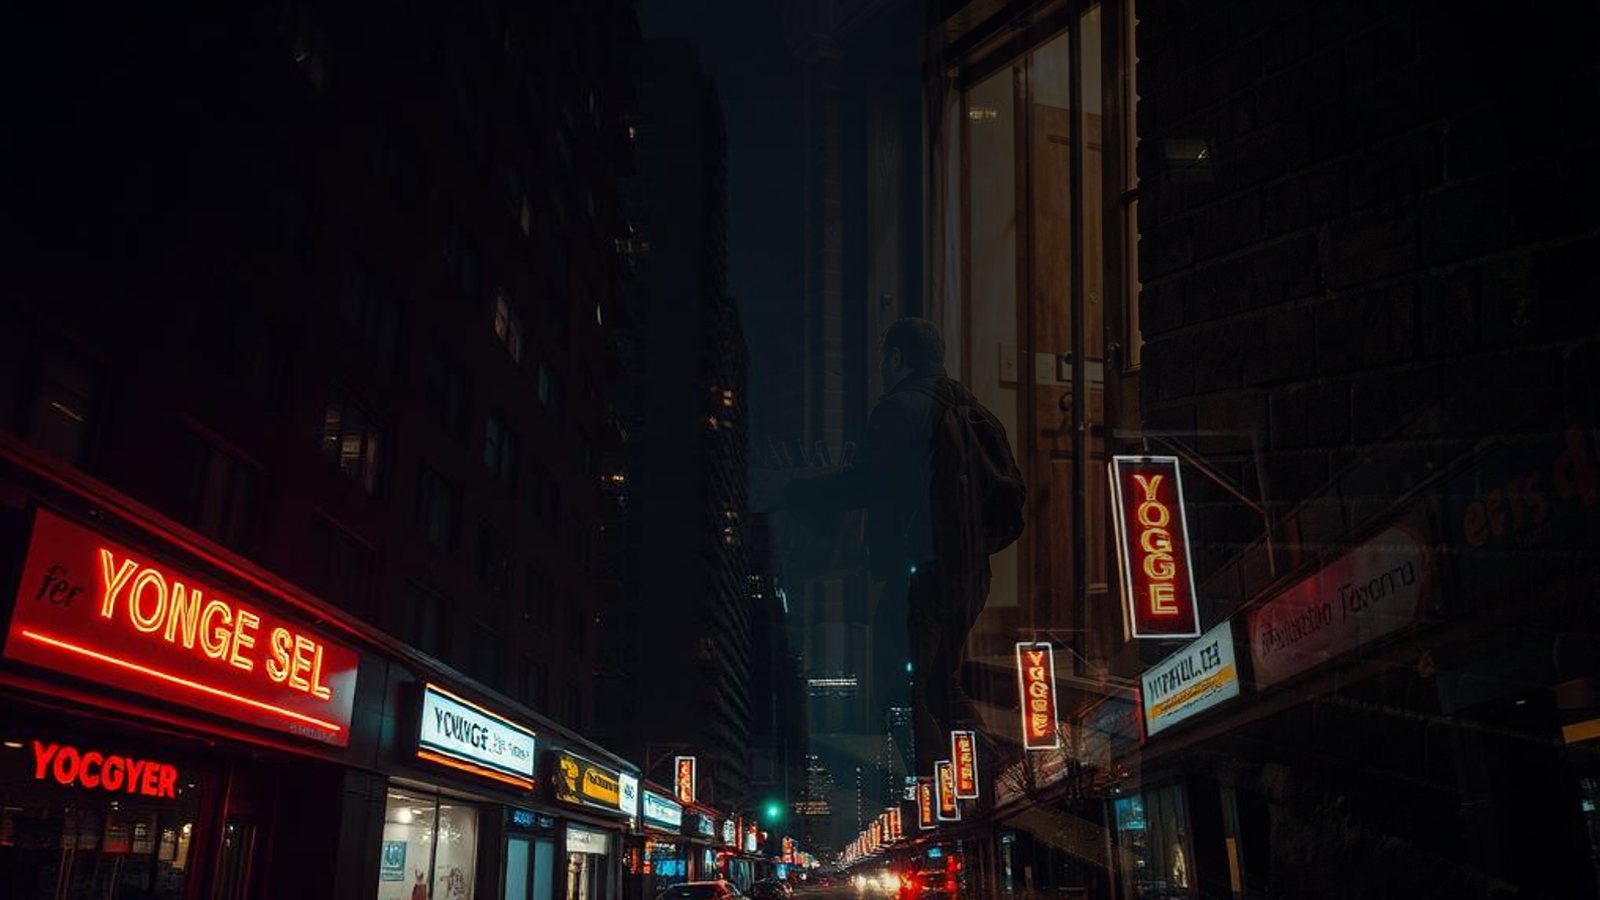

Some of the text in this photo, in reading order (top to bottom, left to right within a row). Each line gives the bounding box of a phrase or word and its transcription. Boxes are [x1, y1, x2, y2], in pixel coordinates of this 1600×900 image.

[1134, 474, 1178, 615] YOGGE
[98, 547, 260, 671] YONGE
[265, 627, 331, 700] SEL
